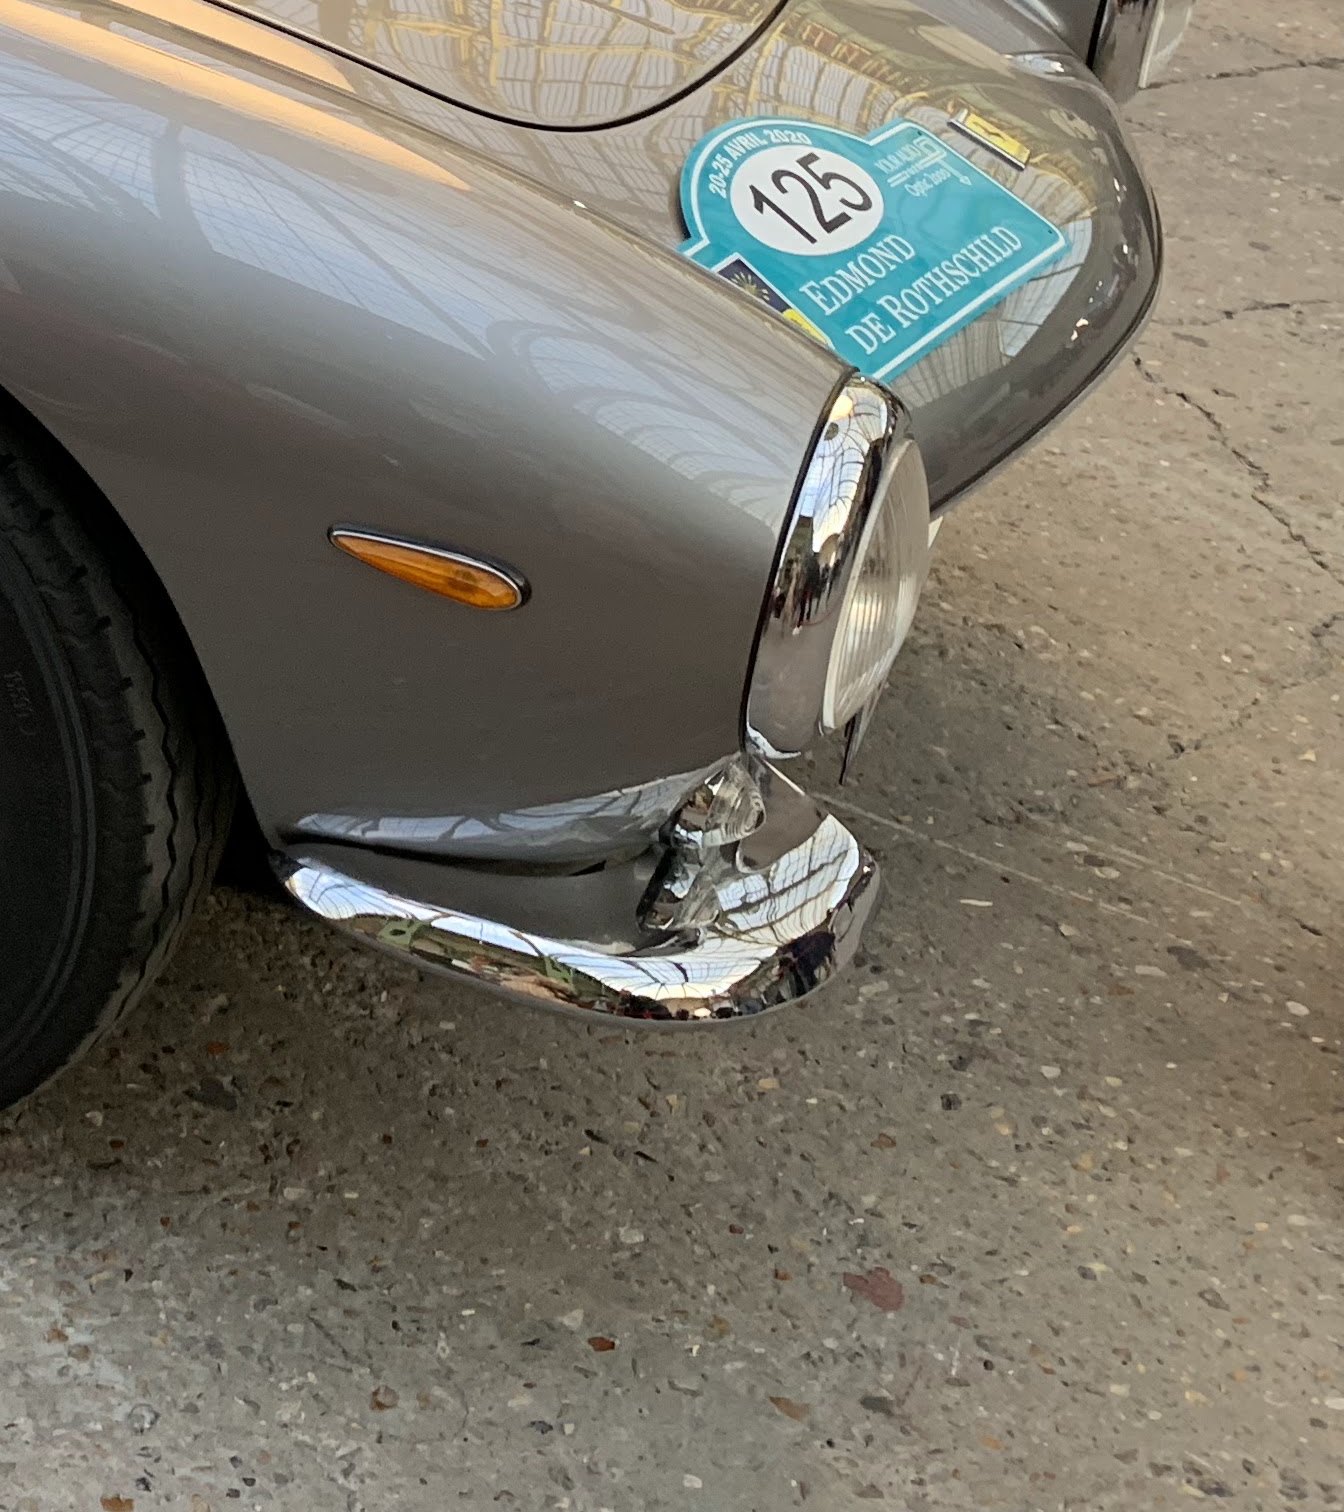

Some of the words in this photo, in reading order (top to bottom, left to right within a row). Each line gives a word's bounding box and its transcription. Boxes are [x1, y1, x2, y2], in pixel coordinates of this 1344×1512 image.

[708, 153, 734, 200] 20-25
[727, 131, 768, 163] AVRIL
[764, 128, 813, 146] 2020
[748, 151, 874, 245] 125
[904, 178, 933, 198] Optic
[798, 234, 916, 316] EDMOND
[844, 312, 896, 356] DE
[876, 225, 1023, 329] ROTHSCHILD
